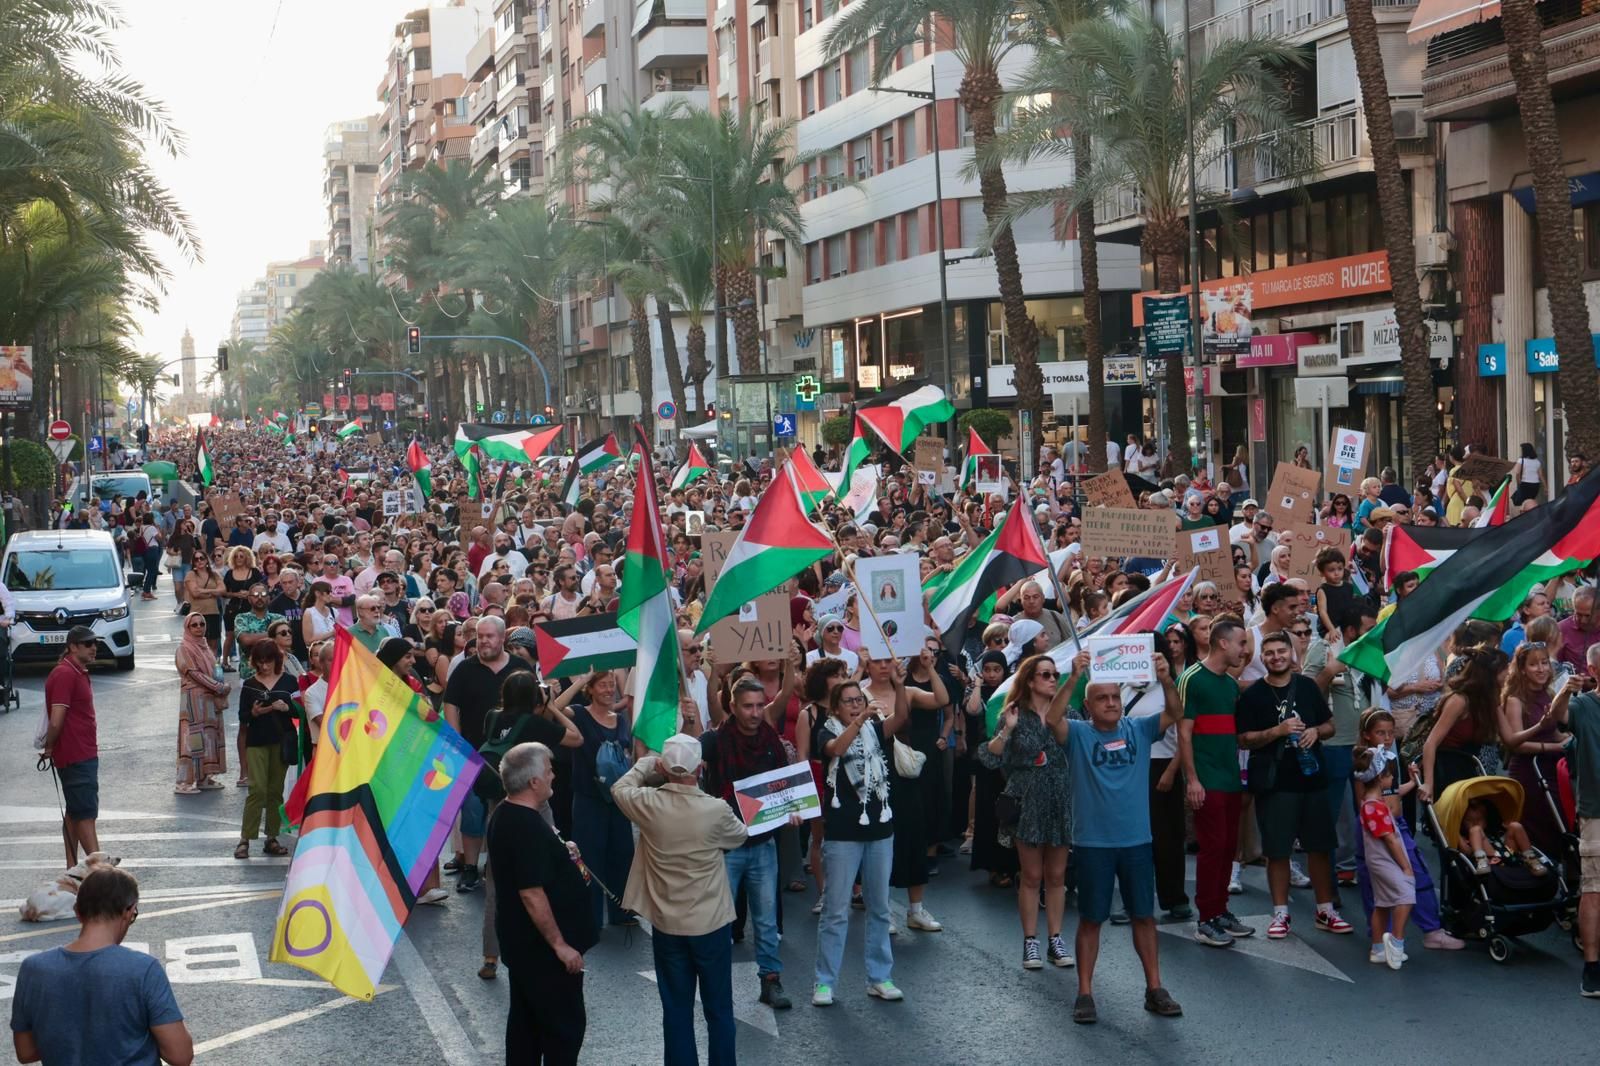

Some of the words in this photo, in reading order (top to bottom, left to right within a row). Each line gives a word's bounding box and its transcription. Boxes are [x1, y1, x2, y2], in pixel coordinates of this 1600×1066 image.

[1261, 282, 1271, 295] TU
[1270, 279, 1293, 293] MARCA
[1292, 277, 1302, 291] DE
[1303, 272, 1335, 289] SEGUROS
[1341, 260, 1385, 288] RUIZRE
[1373, 328, 1400, 346] MIZAP
[1428, 335, 1448, 343] ZAPA
[1539, 351, 1559, 367] Saba
[1052, 374, 1085, 383] TOMASA
[1343, 444, 1356, 452] EN
[1341, 451, 1357, 459] PIE
[45, 635, 65, 643] 5189
[730, 620, 784, 655] YA!!
[1118, 644, 1146, 655] STOP
[1092, 660, 1150, 672] GENOCIDIO
[767, 780, 788, 792] STOP
